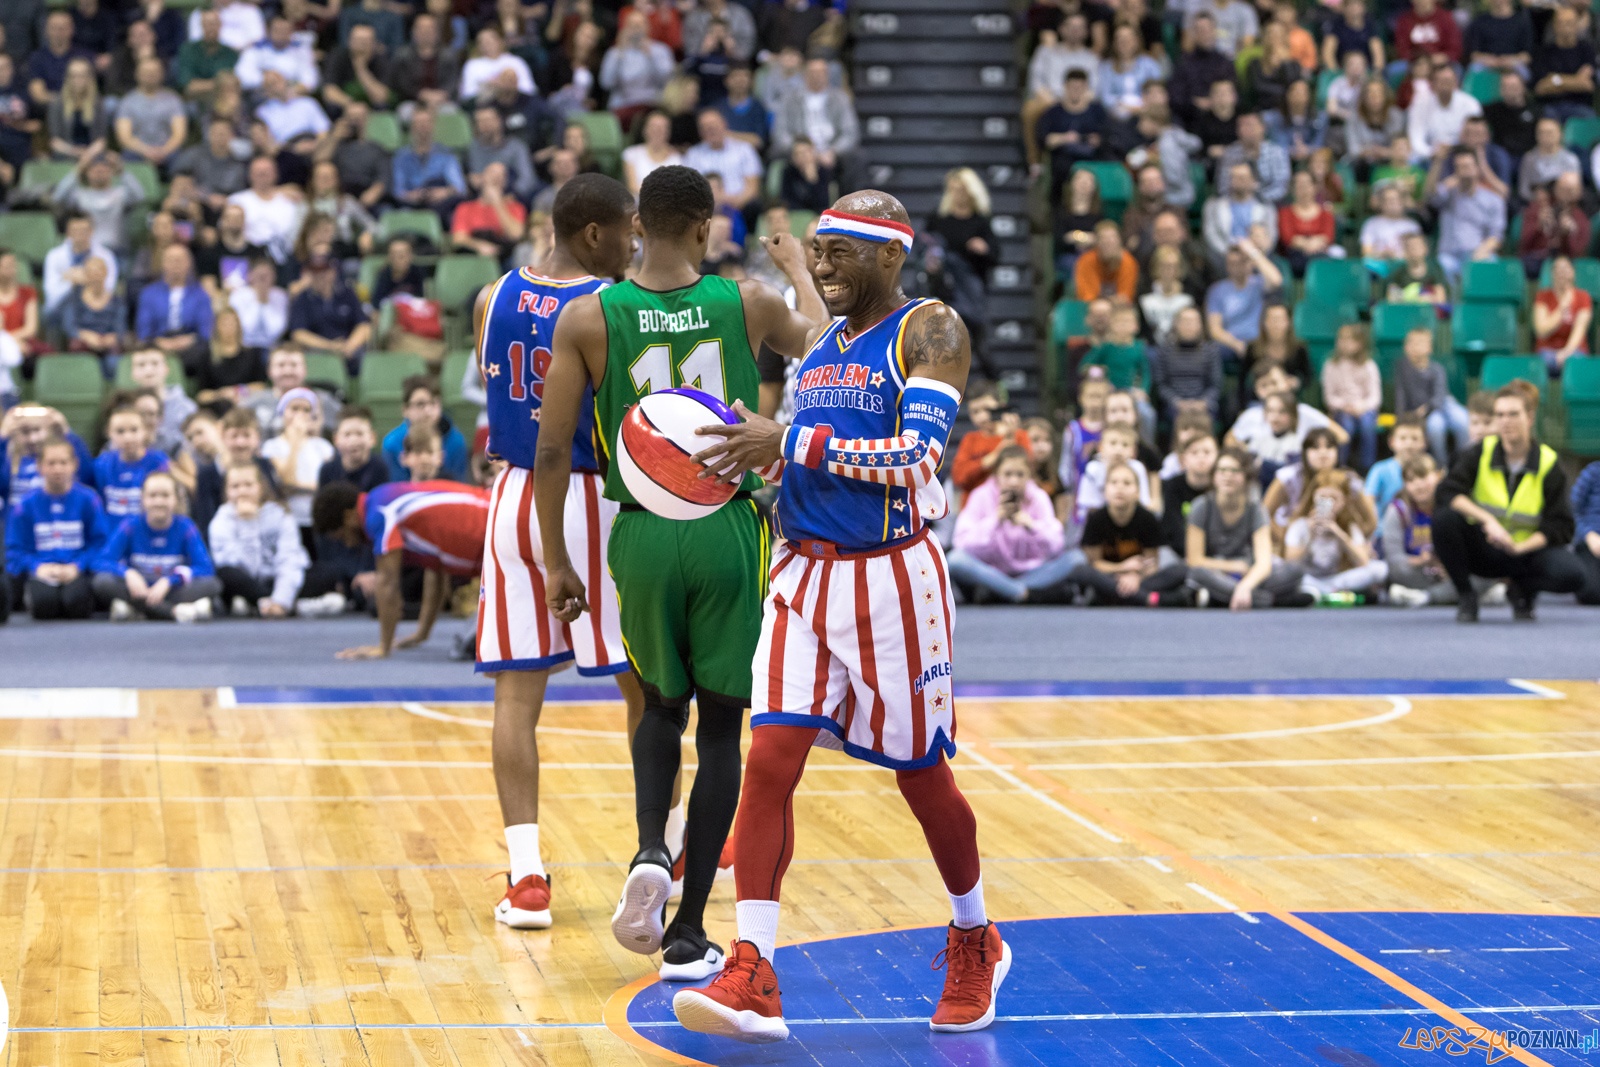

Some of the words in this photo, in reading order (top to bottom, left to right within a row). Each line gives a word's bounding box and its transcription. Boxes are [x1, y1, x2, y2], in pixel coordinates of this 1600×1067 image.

[517, 290, 559, 318] FLIP
[638, 306, 710, 333] BURRELL
[508, 341, 552, 401] 19
[628, 338, 728, 406] 11
[798, 363, 870, 393] HARLEM
[794, 388, 884, 415] OBETROTTERS
[909, 402, 947, 421] HARLEM
[904, 412, 948, 431] GLOBETROTTERS
[914, 661, 952, 695] HARLE
